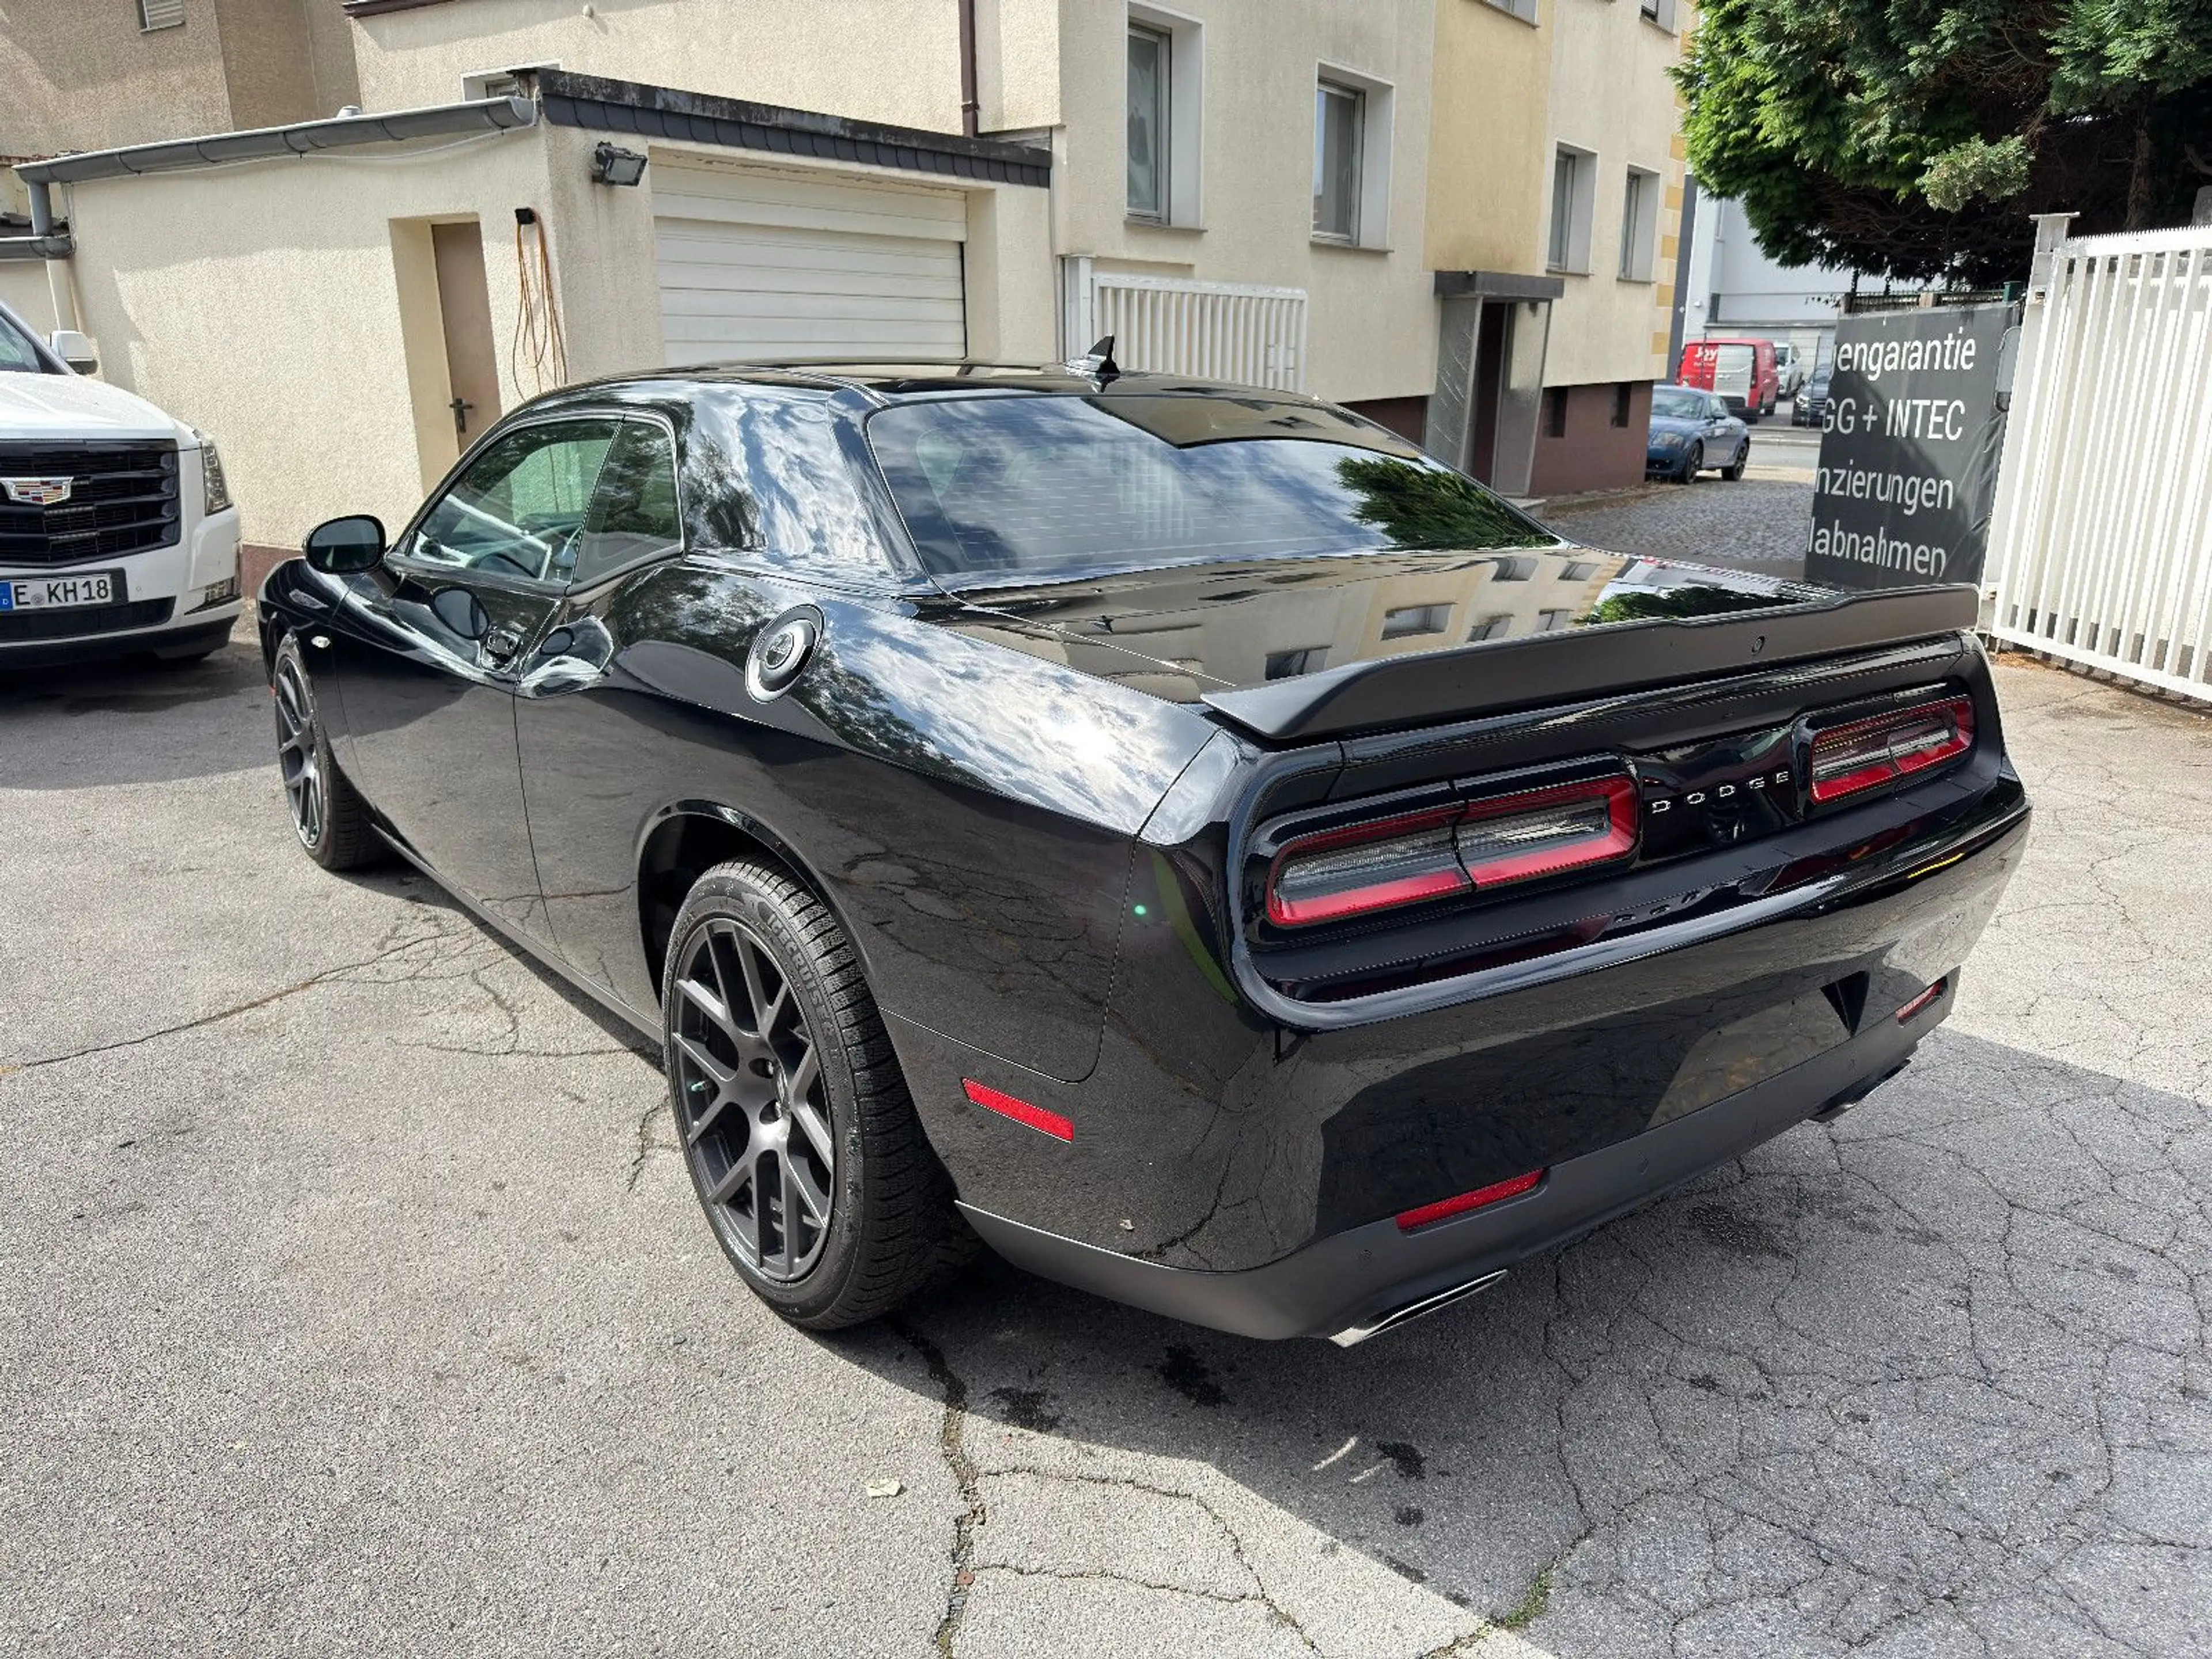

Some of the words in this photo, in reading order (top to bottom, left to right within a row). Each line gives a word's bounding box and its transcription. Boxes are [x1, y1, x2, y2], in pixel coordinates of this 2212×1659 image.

[1833, 327, 1976, 380] engarantie
[1822, 397, 1855, 434] GG
[1885, 398, 1965, 441] INTEC
[1815, 459, 1953, 515] nzierungen
[1808, 516, 1946, 577] labnahmen
[14, 584, 31, 605] E
[1652, 771, 1789, 813] DODGE
